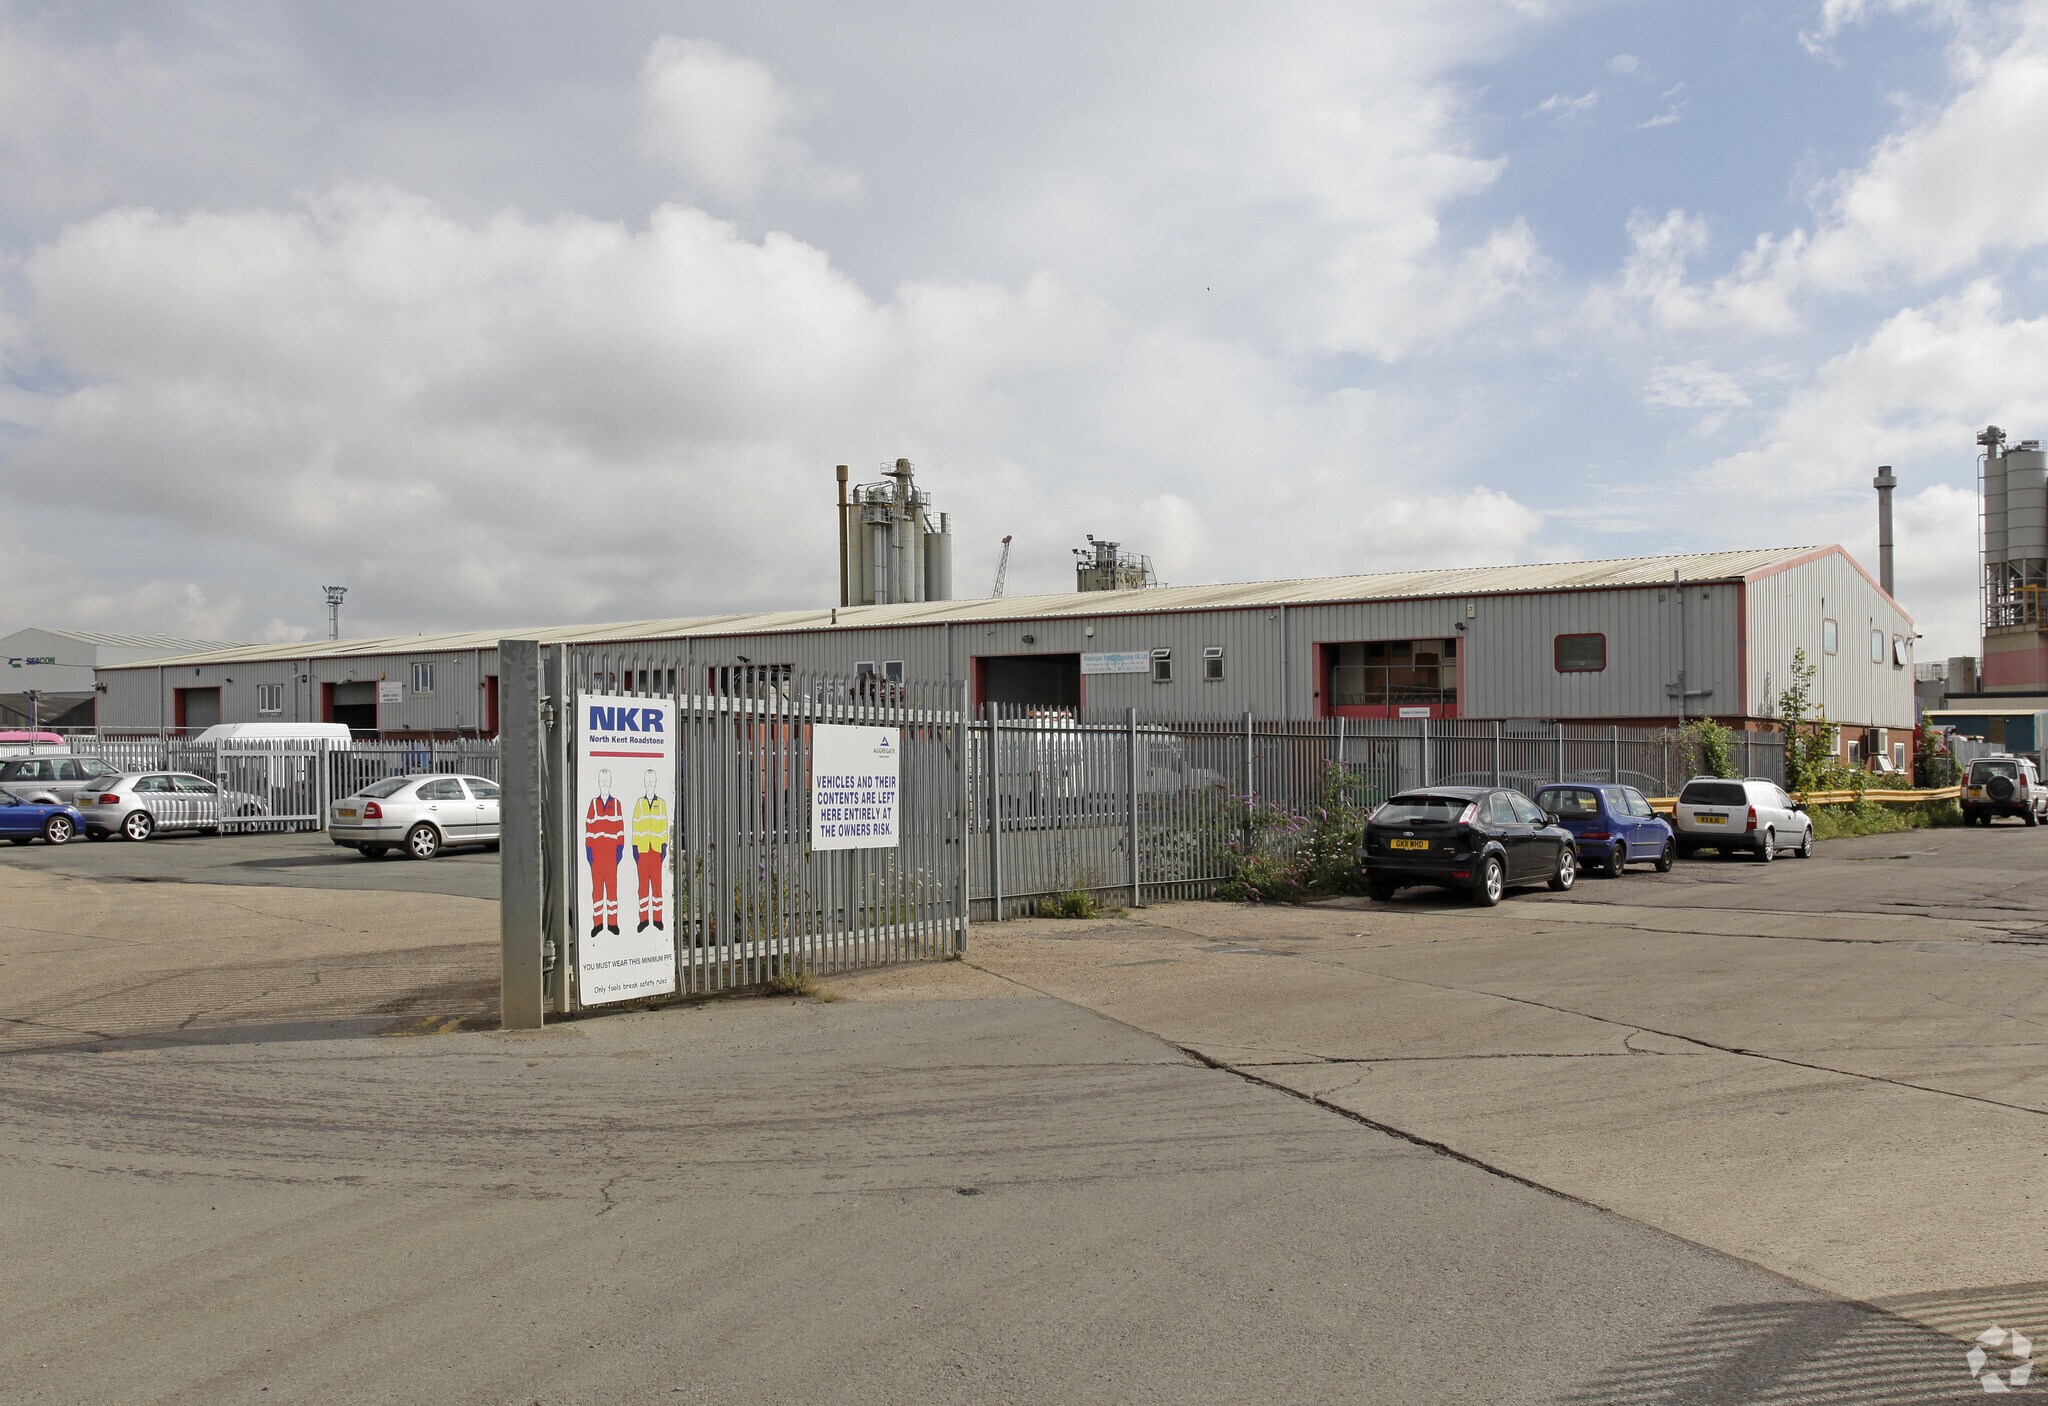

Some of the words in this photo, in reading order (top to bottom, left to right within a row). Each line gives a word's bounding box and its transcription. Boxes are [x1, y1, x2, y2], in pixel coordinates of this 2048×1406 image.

[26, 657, 56, 665] SEACON
[590, 706, 664, 732] NKR
[589, 735, 610, 743] North
[611, 736, 628, 744] Kent
[630, 736, 664, 744] Roadstone
[817, 775, 855, 788] VEHICLES
[857, 776, 873, 788] AND
[875, 776, 896, 788] THEIR
[817, 792, 859, 805] CONTENTS
[861, 792, 876, 804] ARE
[878, 792, 895, 804] LEFT
[821, 808, 842, 821] HERE
[844, 807, 881, 820] ENTIRELY
[882, 807, 892, 819] AT
[821, 824, 836, 838] THE
[838, 823, 871, 837] OWNERS
[873, 823, 892, 835] RISK.
[583, 963, 594, 971] YOU
[596, 961, 611, 970] MUST
[612, 959, 628, 968] WEAR
[629, 957, 641, 965] THIS
[642, 955, 664, 964] MINIMUM
[594, 985, 607, 994] Only
[608, 983, 622, 992] fools
[623, 981, 638, 990] break
[639, 979, 655, 988] safety
